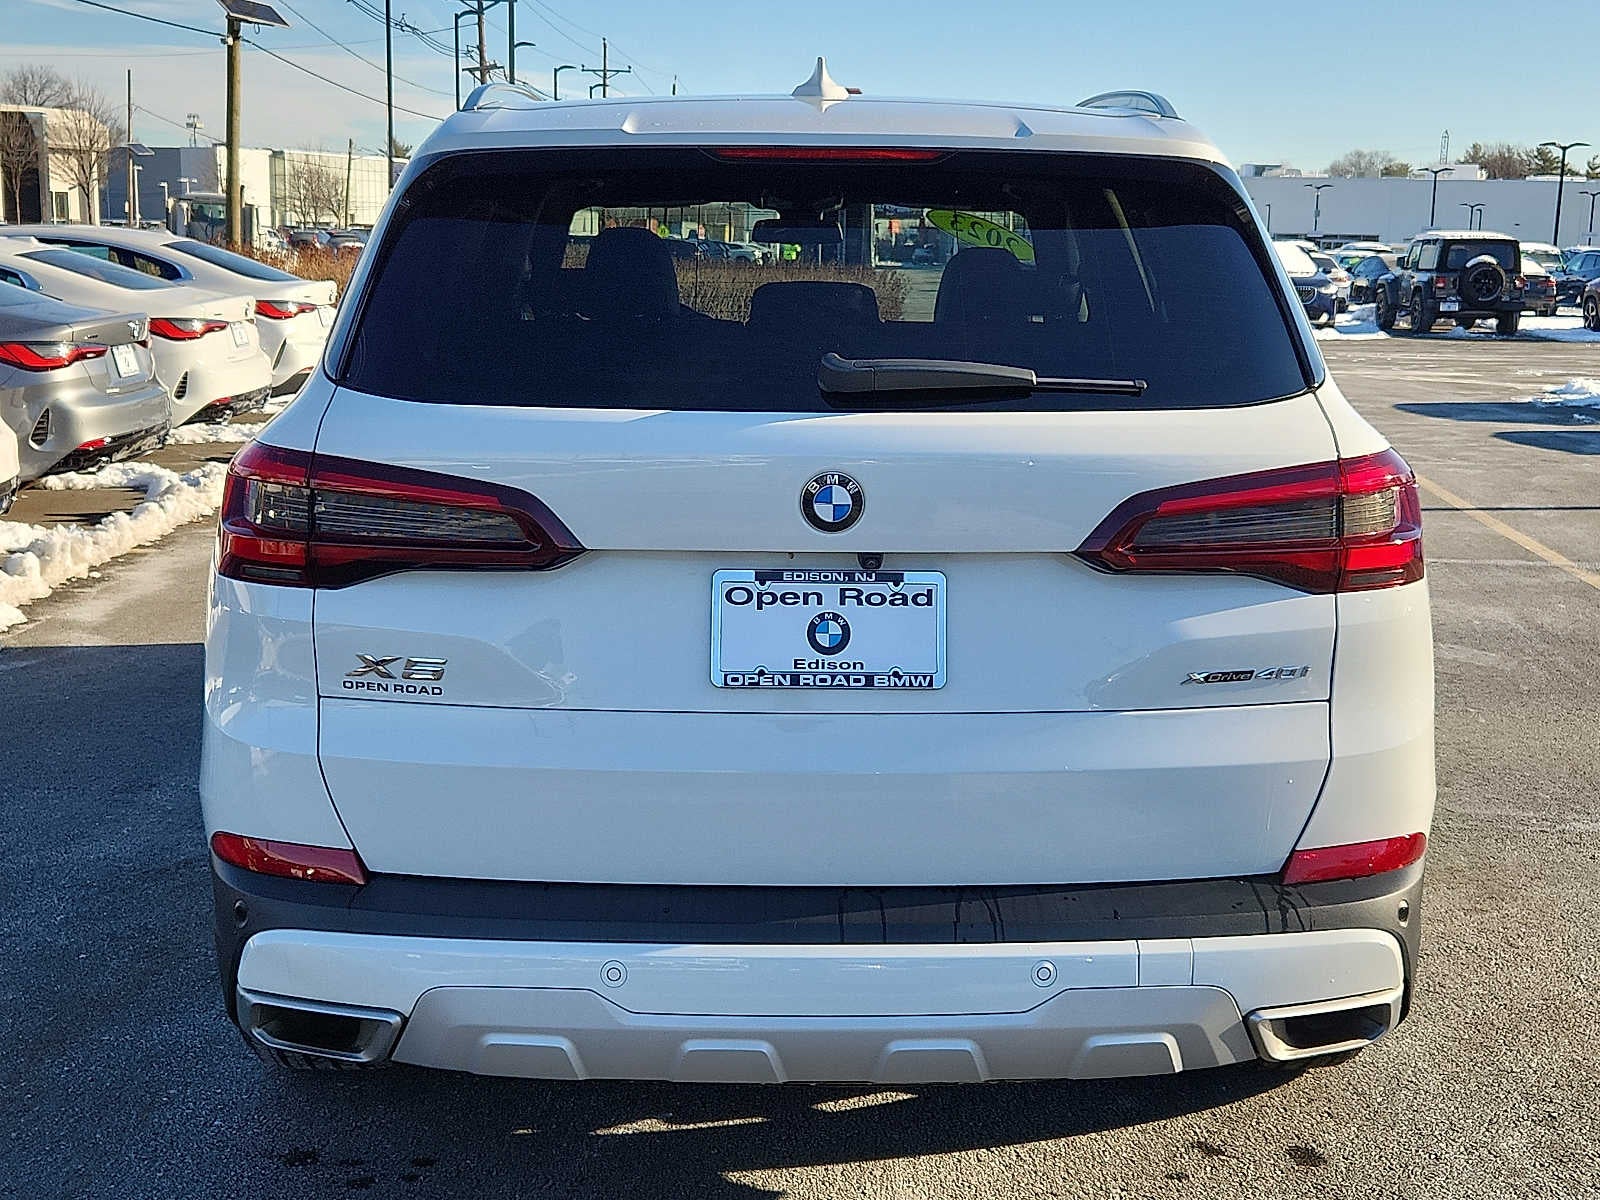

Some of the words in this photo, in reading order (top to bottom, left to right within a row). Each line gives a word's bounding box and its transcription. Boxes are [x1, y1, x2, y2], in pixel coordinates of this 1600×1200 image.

[808, 474, 859, 495] BMW
[783, 572, 849, 582] EDISON,
[854, 572, 876, 582] NJ
[724, 586, 824, 611] Open
[839, 587, 933, 607] Road
[812, 613, 847, 626] BMW
[344, 653, 448, 681] X5
[793, 658, 865, 671] Edison
[726, 674, 791, 687] OPEN
[799, 674, 866, 687] ROAD
[873, 674, 931, 687] BMW
[342, 680, 389, 692] OPEN
[393, 683, 443, 696] ROAD
